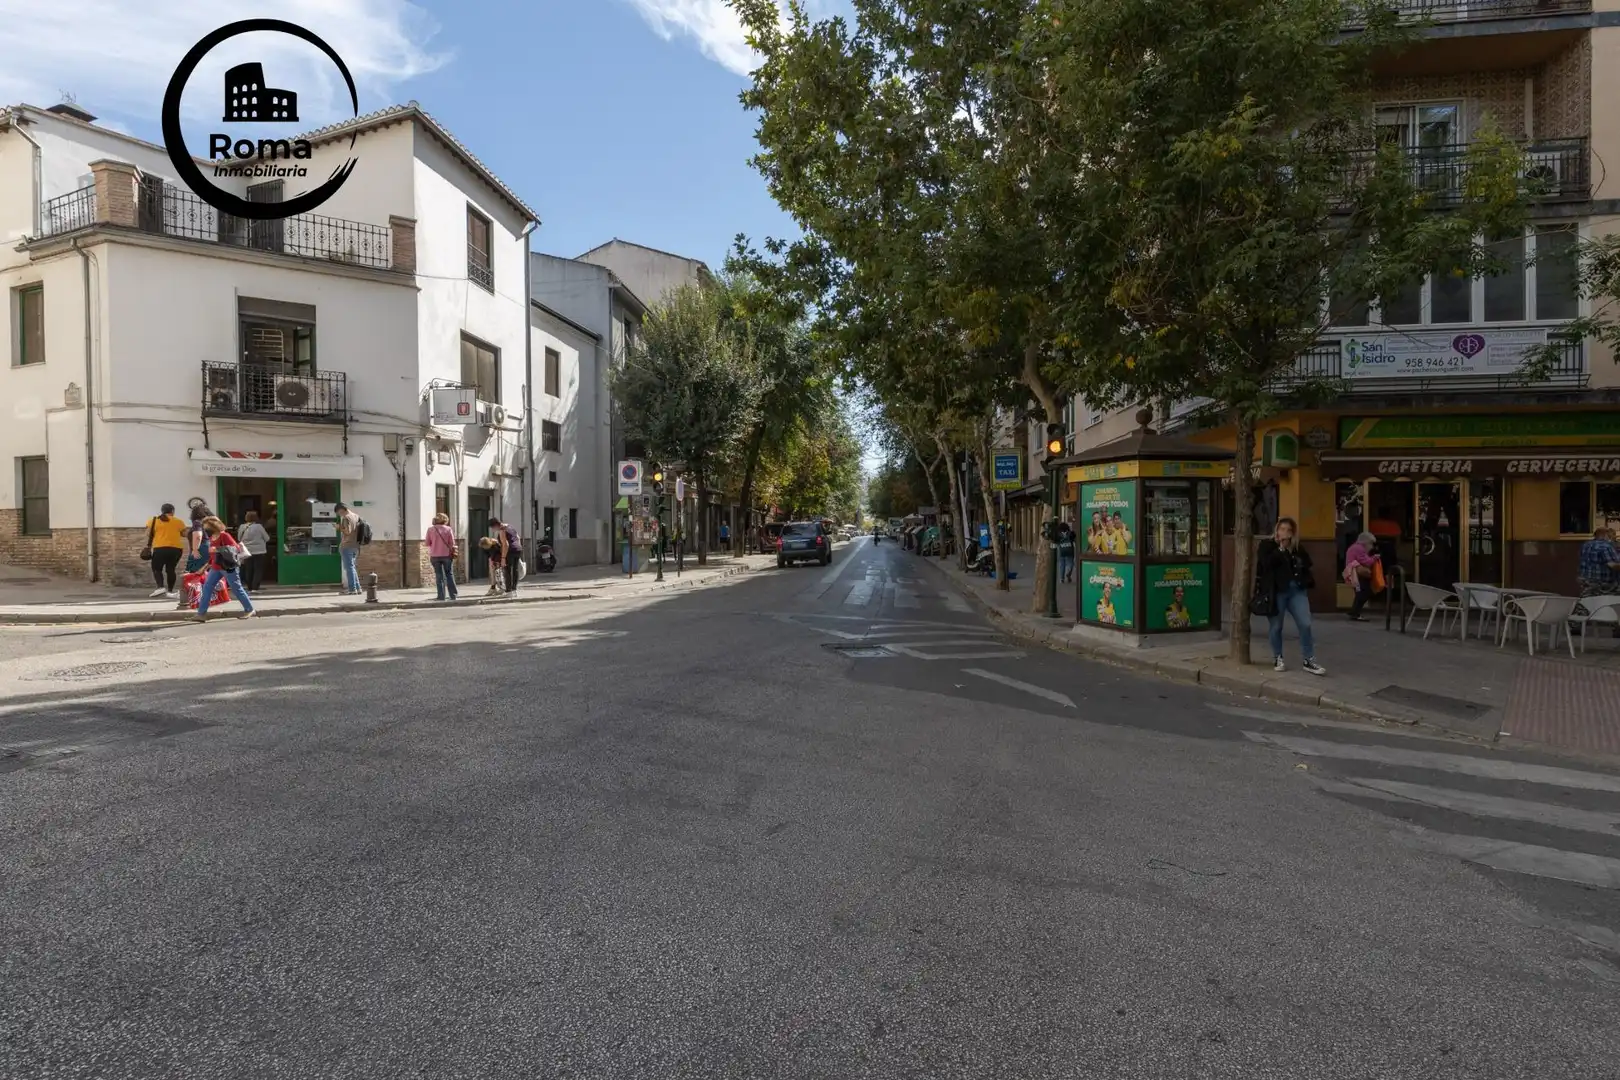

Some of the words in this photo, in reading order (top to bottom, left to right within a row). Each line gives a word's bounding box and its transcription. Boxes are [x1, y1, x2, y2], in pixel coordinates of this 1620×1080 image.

[1361, 341, 1382, 352] San
[1362, 353, 1396, 363] Isidro
[1405, 358, 1423, 368] 958
[1426, 357, 1445, 367] 946
[1447, 356, 1465, 366] 421
[232, 464, 241, 472] de
[242, 465, 257, 473] Dios
[1378, 459, 1473, 474] CAFETERIA
[1506, 458, 1620, 474] CERVECERIA
